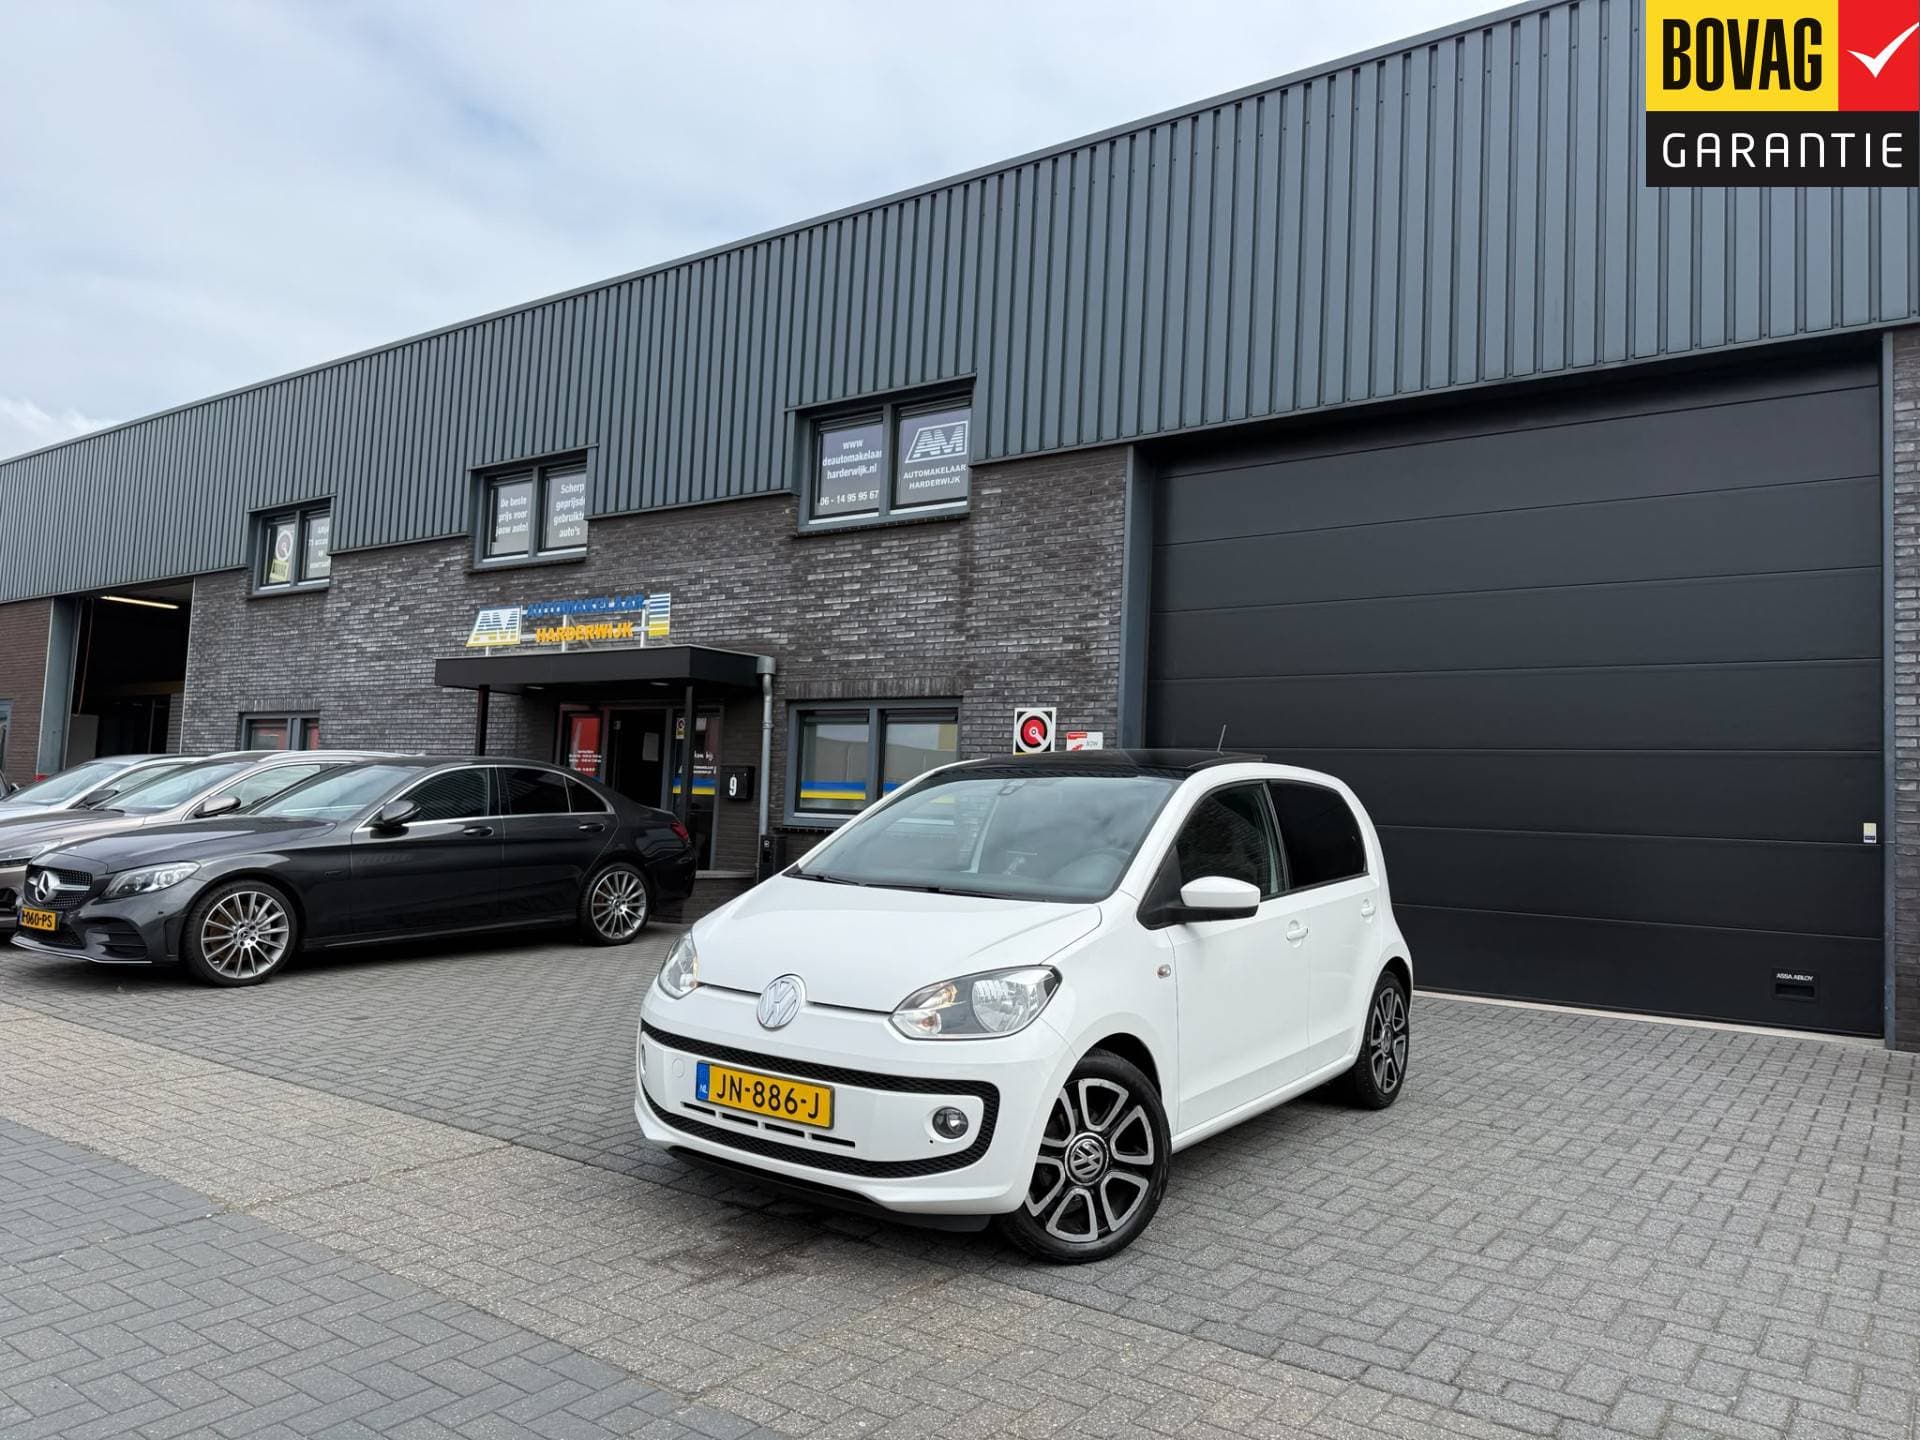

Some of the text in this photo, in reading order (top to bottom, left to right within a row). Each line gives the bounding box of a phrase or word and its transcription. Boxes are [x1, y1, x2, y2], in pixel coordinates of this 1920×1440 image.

[842, 439, 864, 449] www
[827, 463, 878, 480] harderwijk.nl
[903, 464, 967, 479] AUTOMAKELAAR
[559, 483, 585, 494] Scherp
[909, 476, 961, 489] HARDERWIJK
[820, 496, 829, 506] 06
[535, 620, 634, 643] HARDERWIJK
[729, 776, 737, 797] 9
[716, 1073, 820, 1119] JN-886-J
